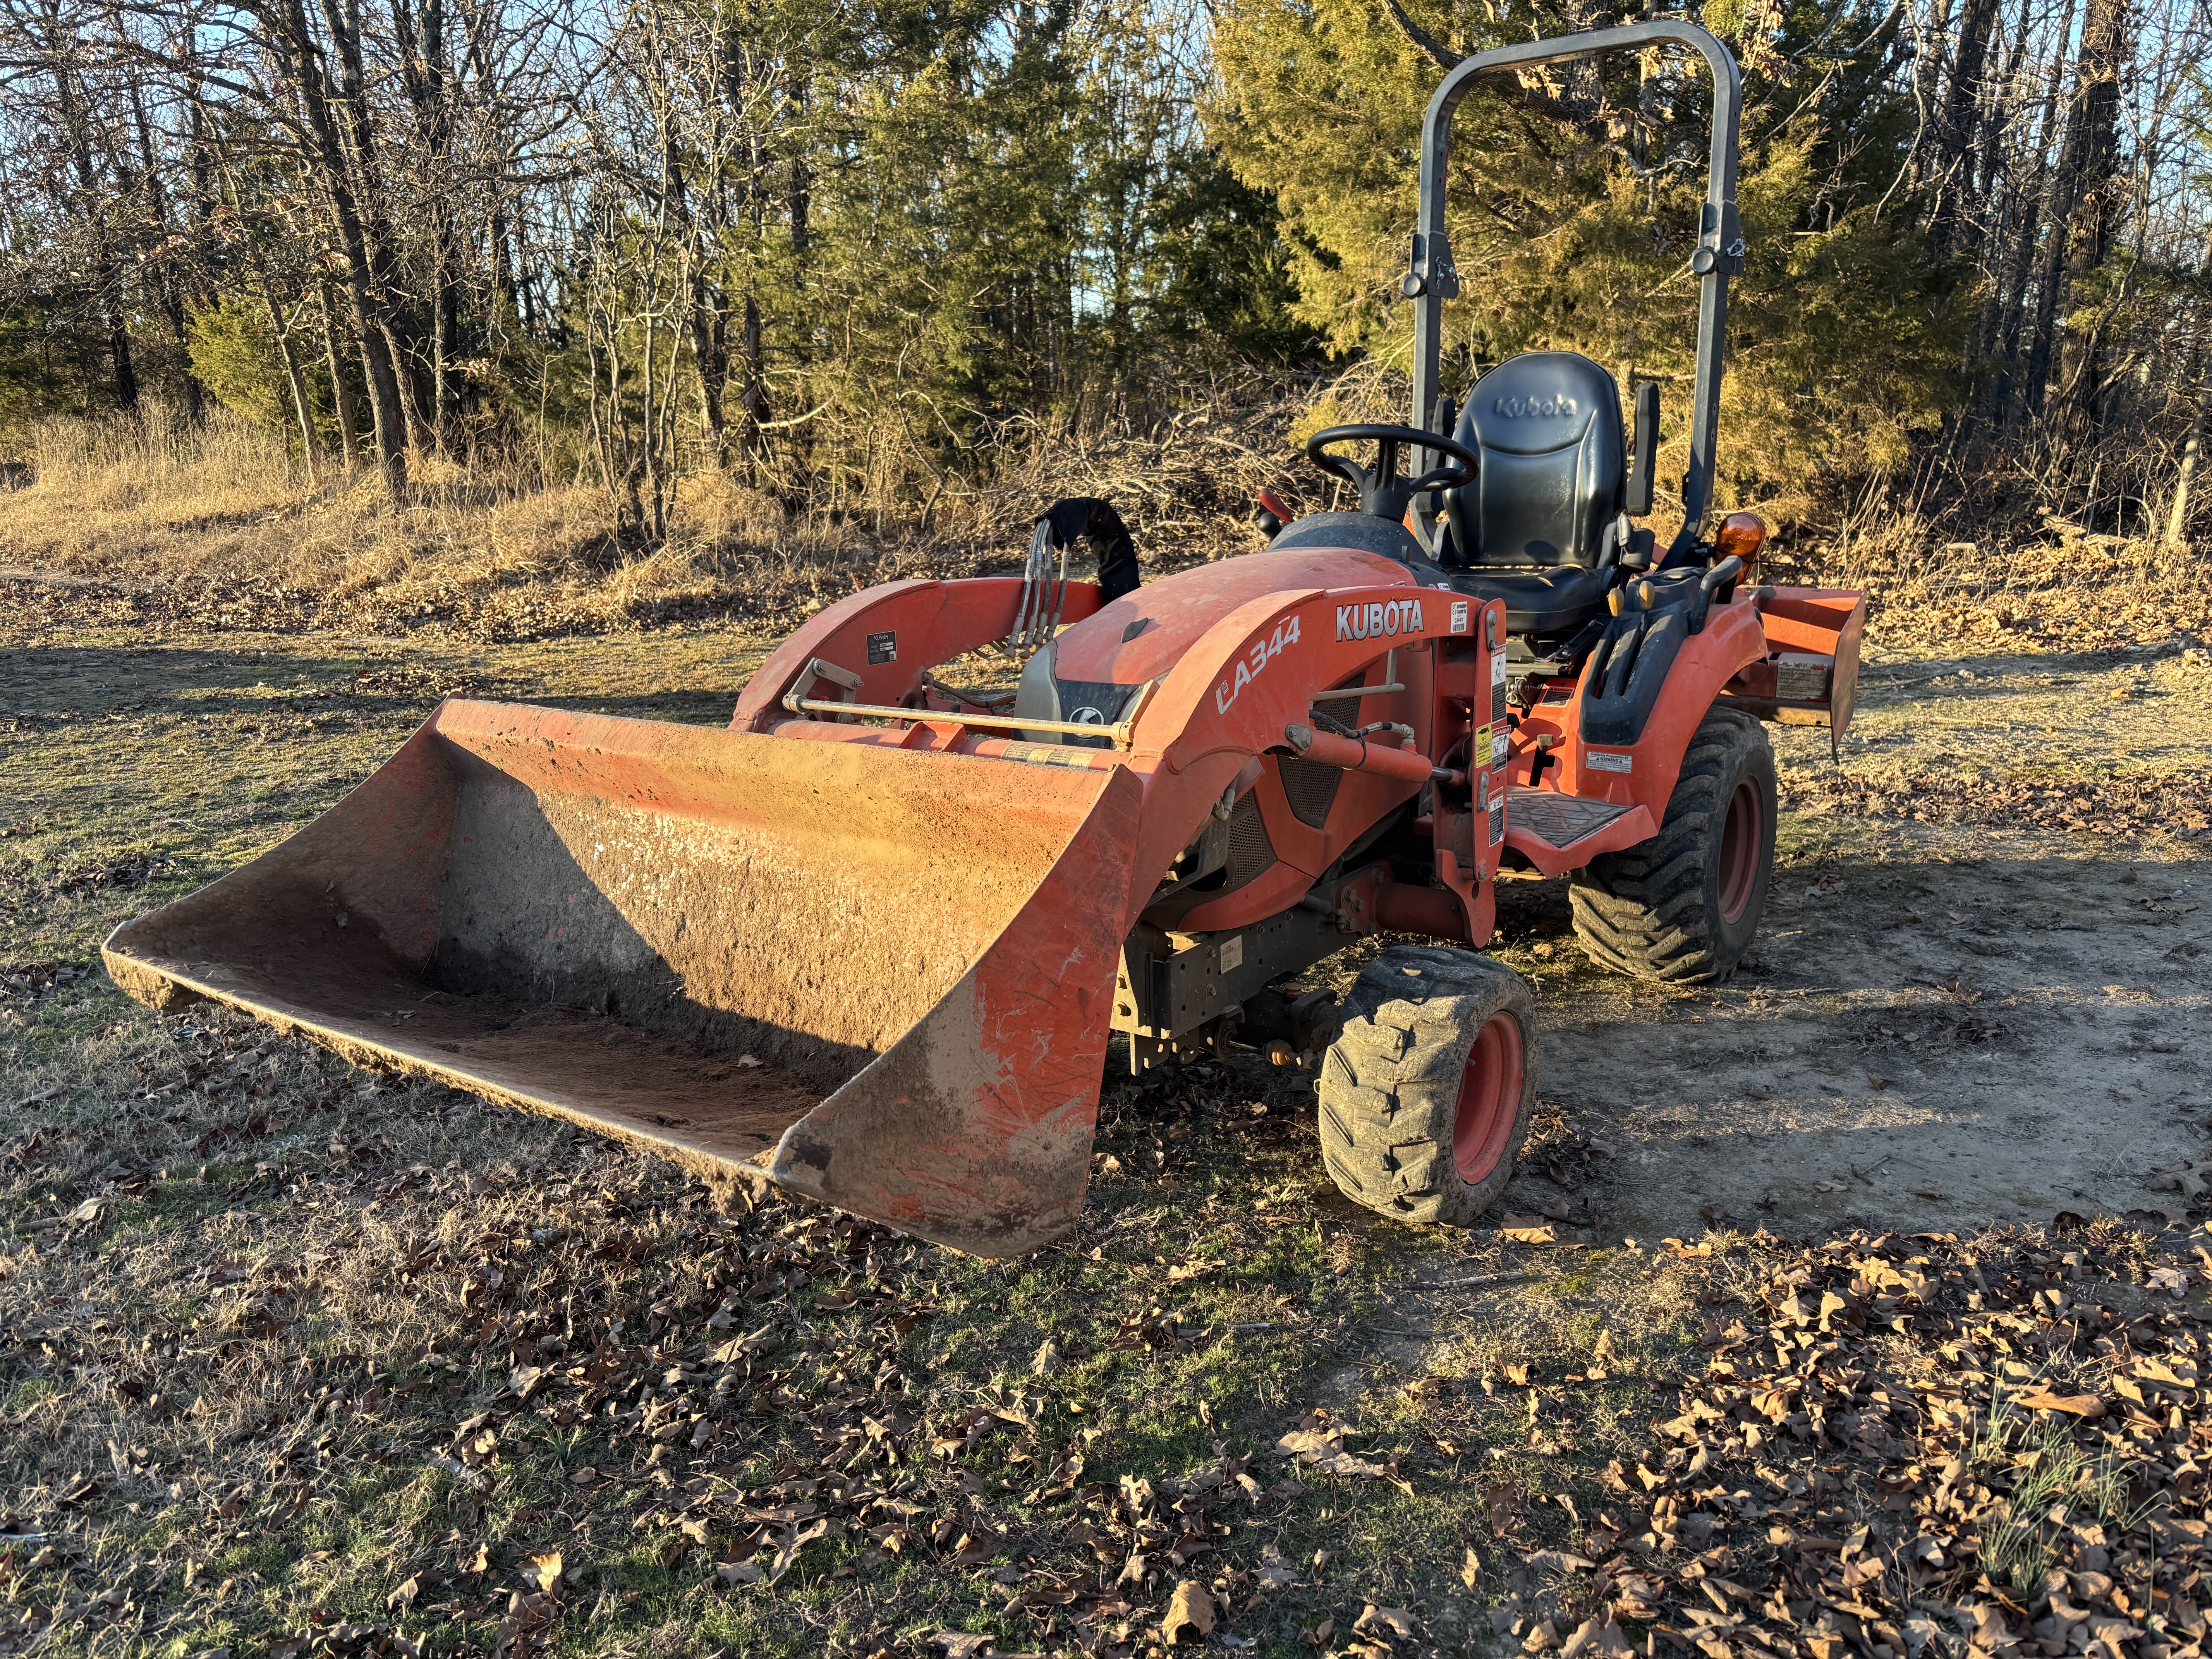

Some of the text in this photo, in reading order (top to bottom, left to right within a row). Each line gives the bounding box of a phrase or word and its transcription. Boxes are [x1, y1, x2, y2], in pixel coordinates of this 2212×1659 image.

[1496, 395, 1577, 417] Kubota
[1336, 599, 1424, 642] KUBOTA
[1216, 615, 1300, 714] LA344
[1495, 728, 1510, 737] DANGER
